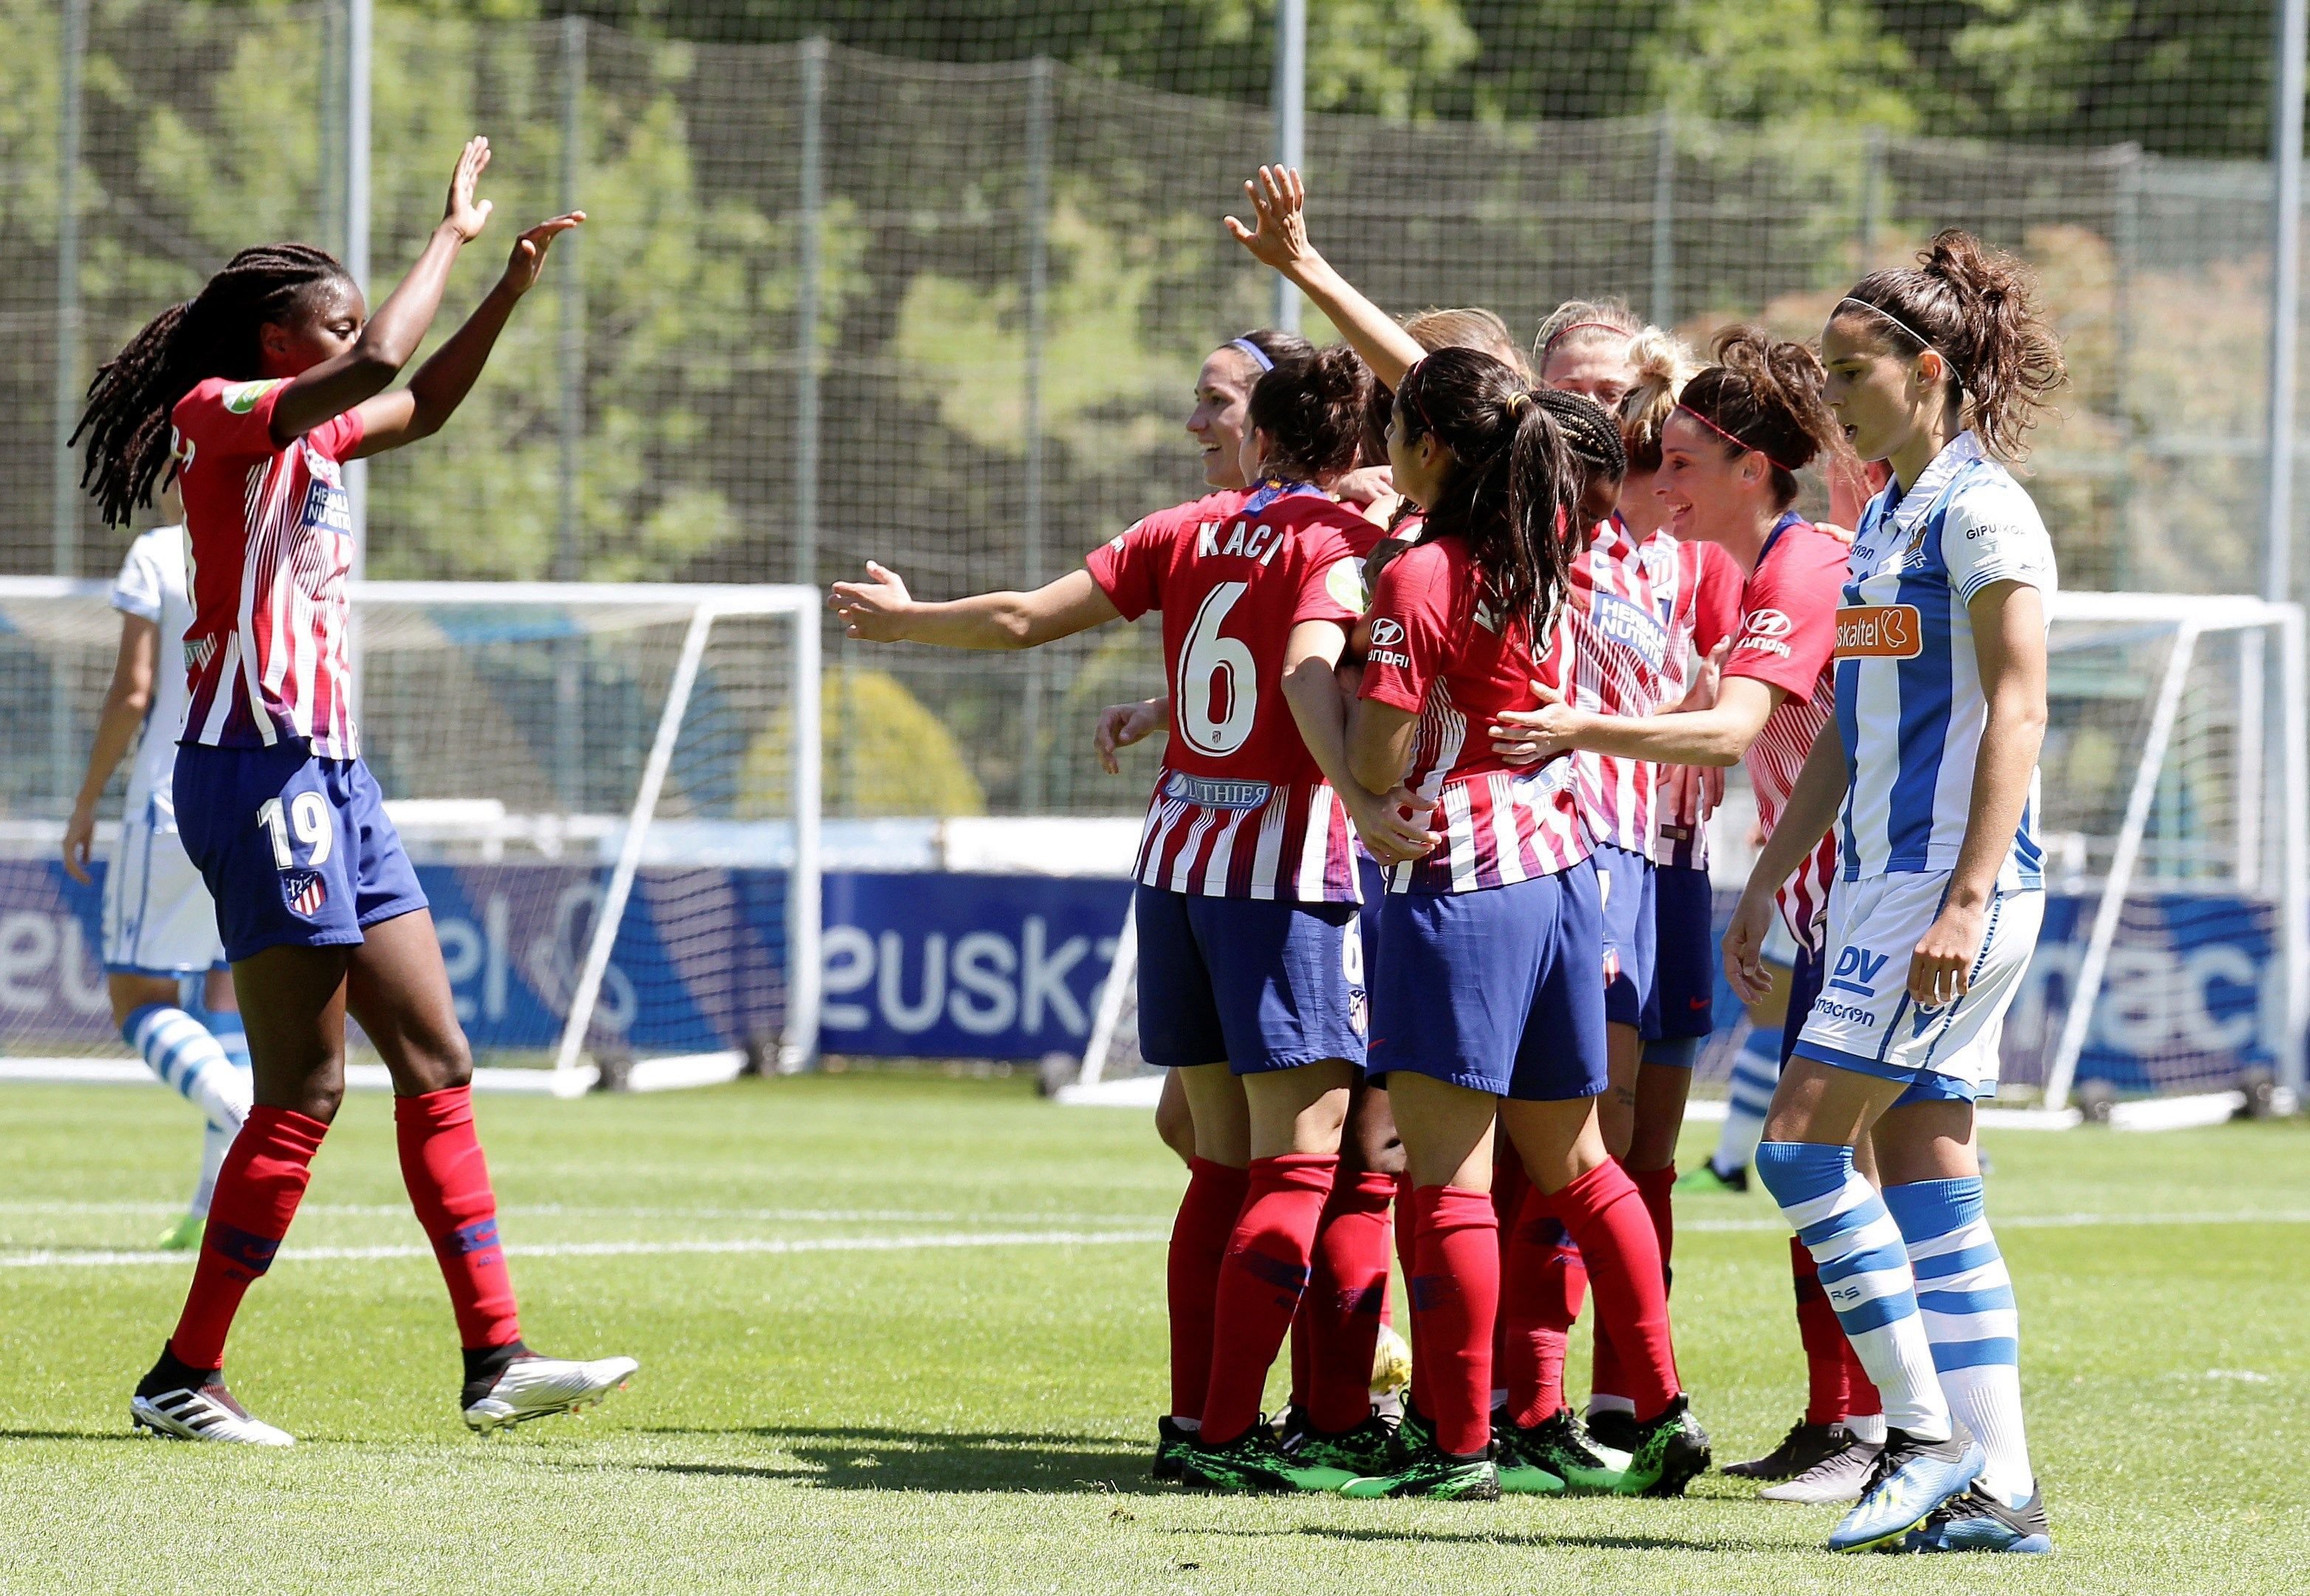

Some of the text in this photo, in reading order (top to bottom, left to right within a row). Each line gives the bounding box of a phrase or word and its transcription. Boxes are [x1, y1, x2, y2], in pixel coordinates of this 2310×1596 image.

[1198, 521, 1284, 566] KACI
[1834, 617, 1879, 648] skaltel
[1176, 581, 1258, 758] 6
[256, 790, 333, 871] 19
[1833, 945, 1889, 984] DV
[1831, 1286, 1860, 1301] RS
